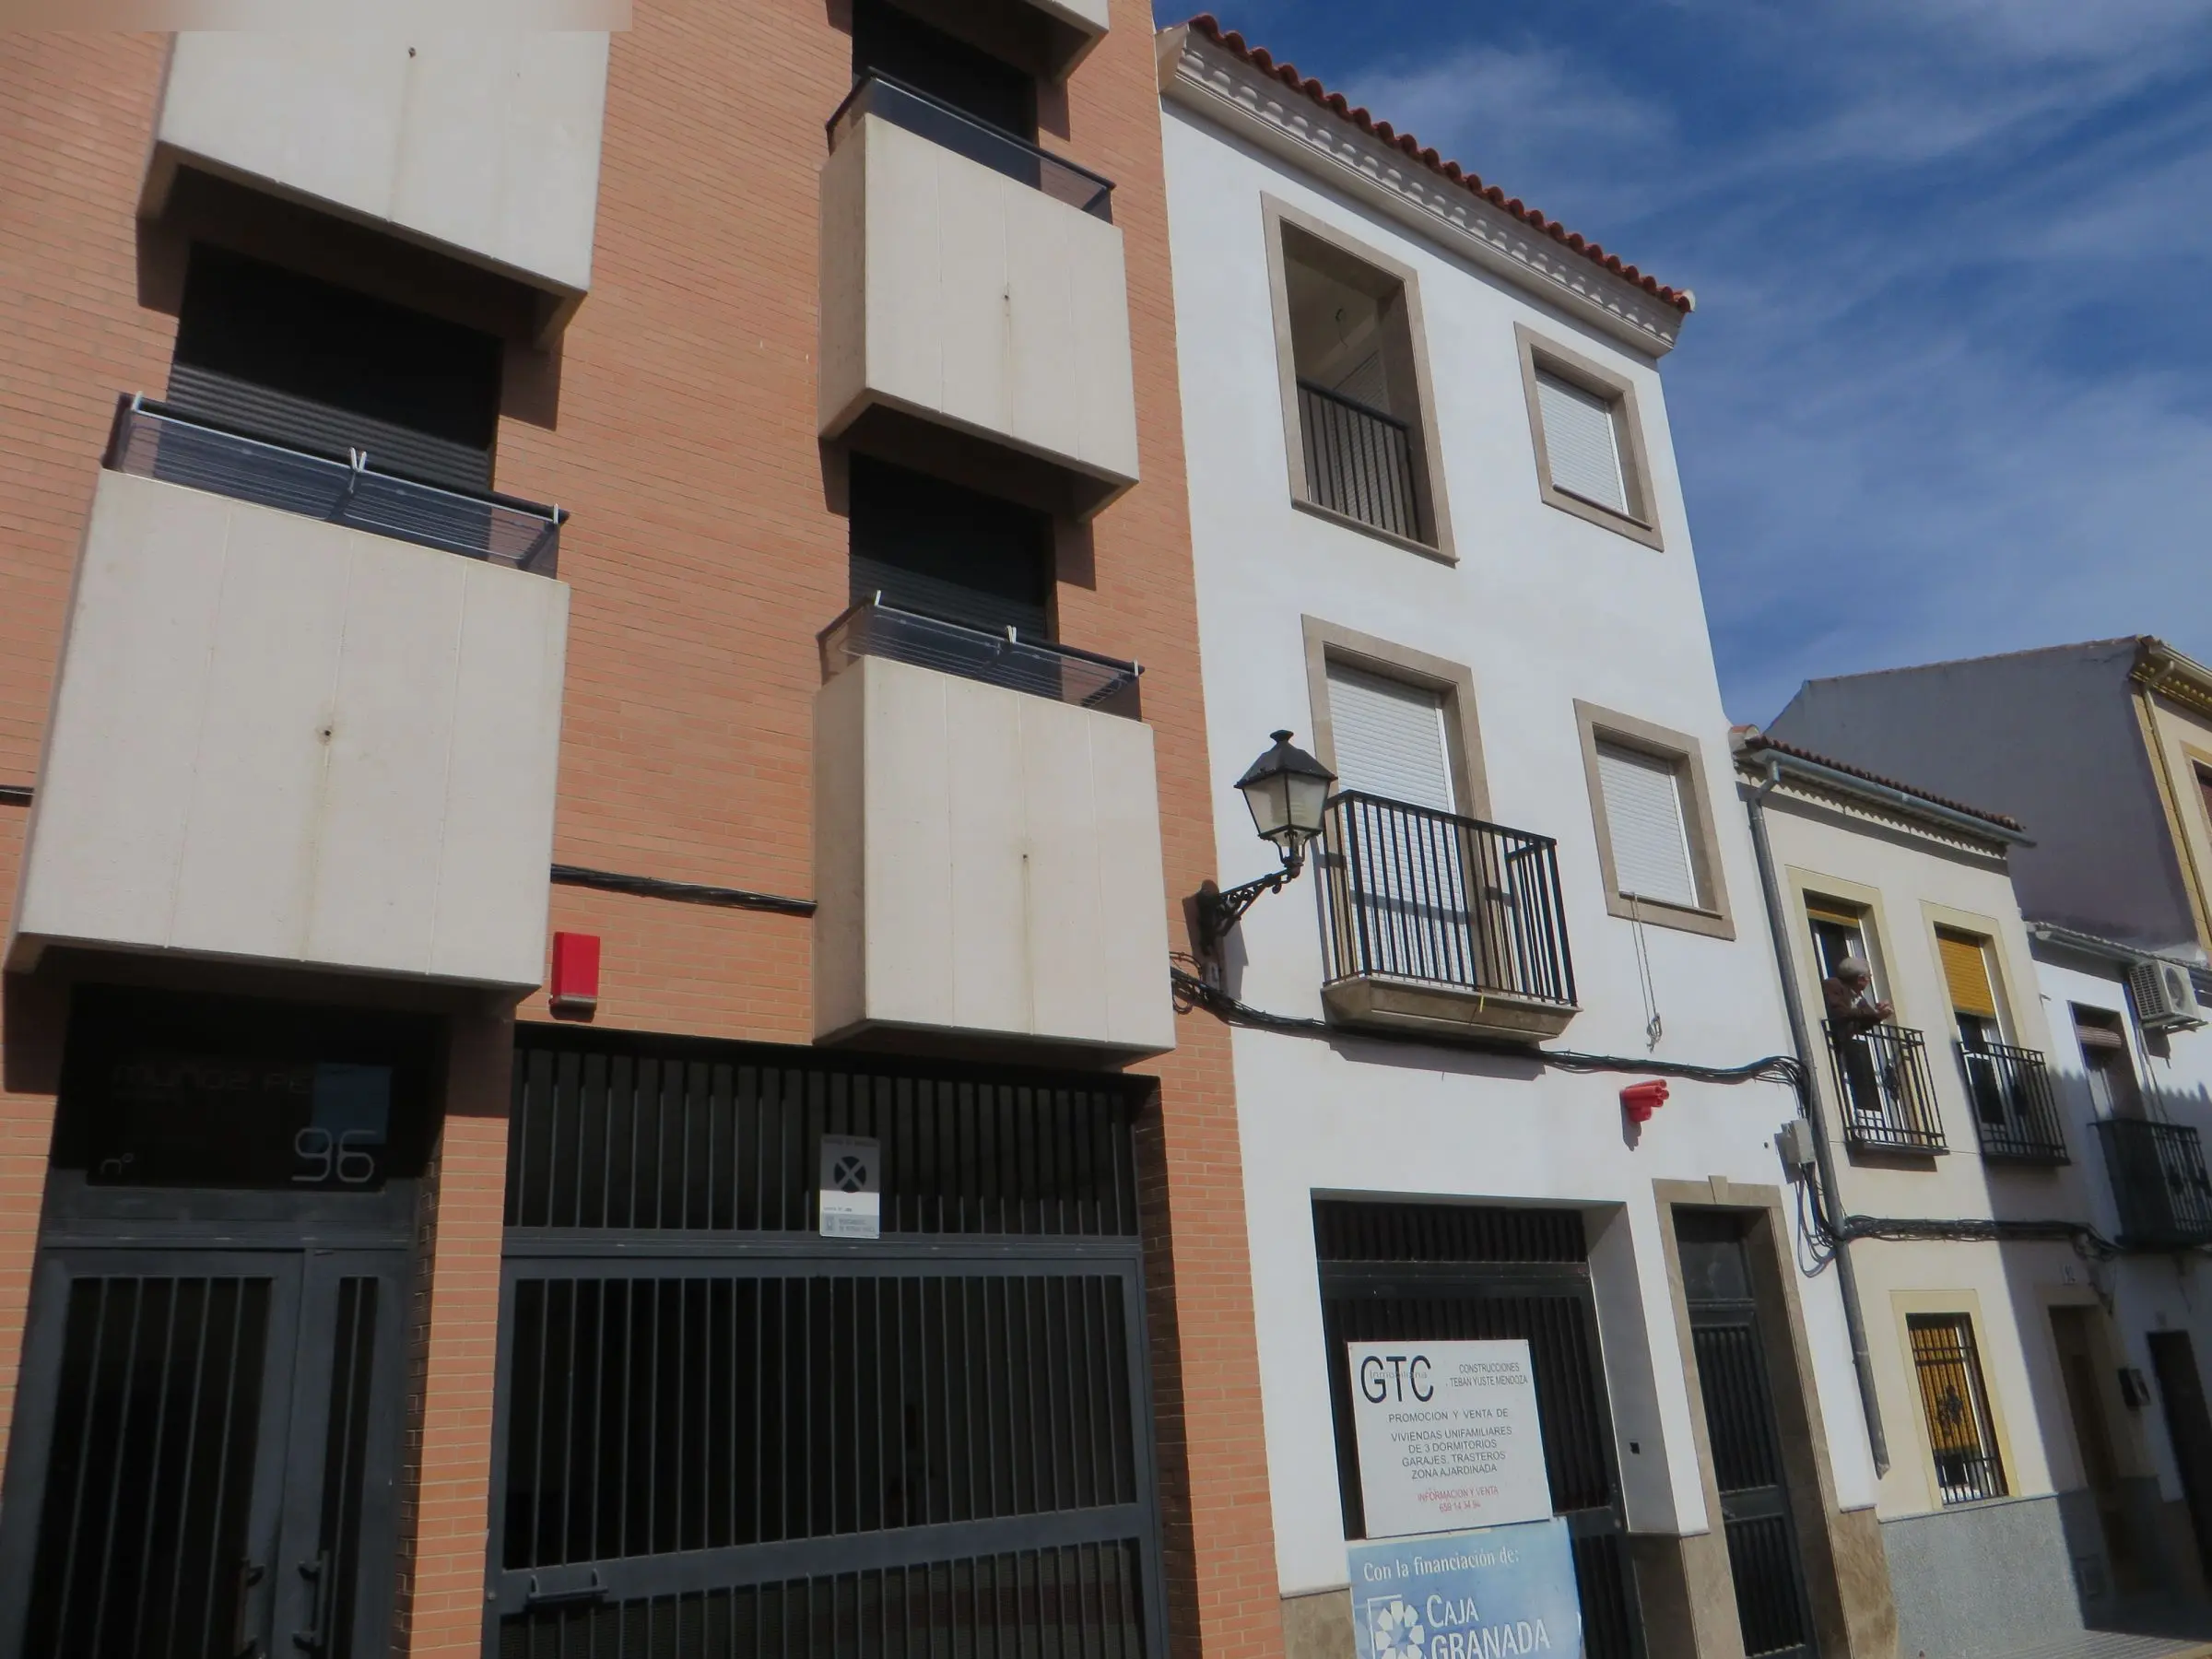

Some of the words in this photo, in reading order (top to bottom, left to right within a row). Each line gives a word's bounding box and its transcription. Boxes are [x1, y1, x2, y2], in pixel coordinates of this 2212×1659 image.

[291, 1126, 378, 1183] 96
[1458, 1362, 1520, 1374] CONSTRUCCIONES
[1360, 1355, 1434, 1404] GTC
[1496, 1374, 1528, 1385] MENDOZA
[1388, 1411, 1448, 1423] PROMOCION
[1453, 1410, 1459, 1419] Y
[1463, 1408, 1493, 1418] VENTA
[1497, 1407, 1509, 1418] DE
[1390, 1430, 1442, 1442] VIVIENDAS
[1444, 1426, 1512, 1439] UNIFAMILIARES
[1408, 1443, 1422, 1453] DE
[1432, 1439, 1498, 1452] DORMITORIOS
[1452, 1451, 1506, 1463] TRASTEROS
[1411, 1469, 1439, 1480] ZONA
[1440, 1464, 1498, 1477] AJARDINADA
[1476, 1486, 1499, 1497] VENTA
[1363, 1562, 1392, 1583] Con
[1395, 1559, 1409, 1579] la
[1413, 1550, 1495, 1576] financiación
[1500, 1546, 1520, 1565] de:
[1426, 1594, 1480, 1629] CAJA
[1430, 1618, 1551, 1659] GRANADA
